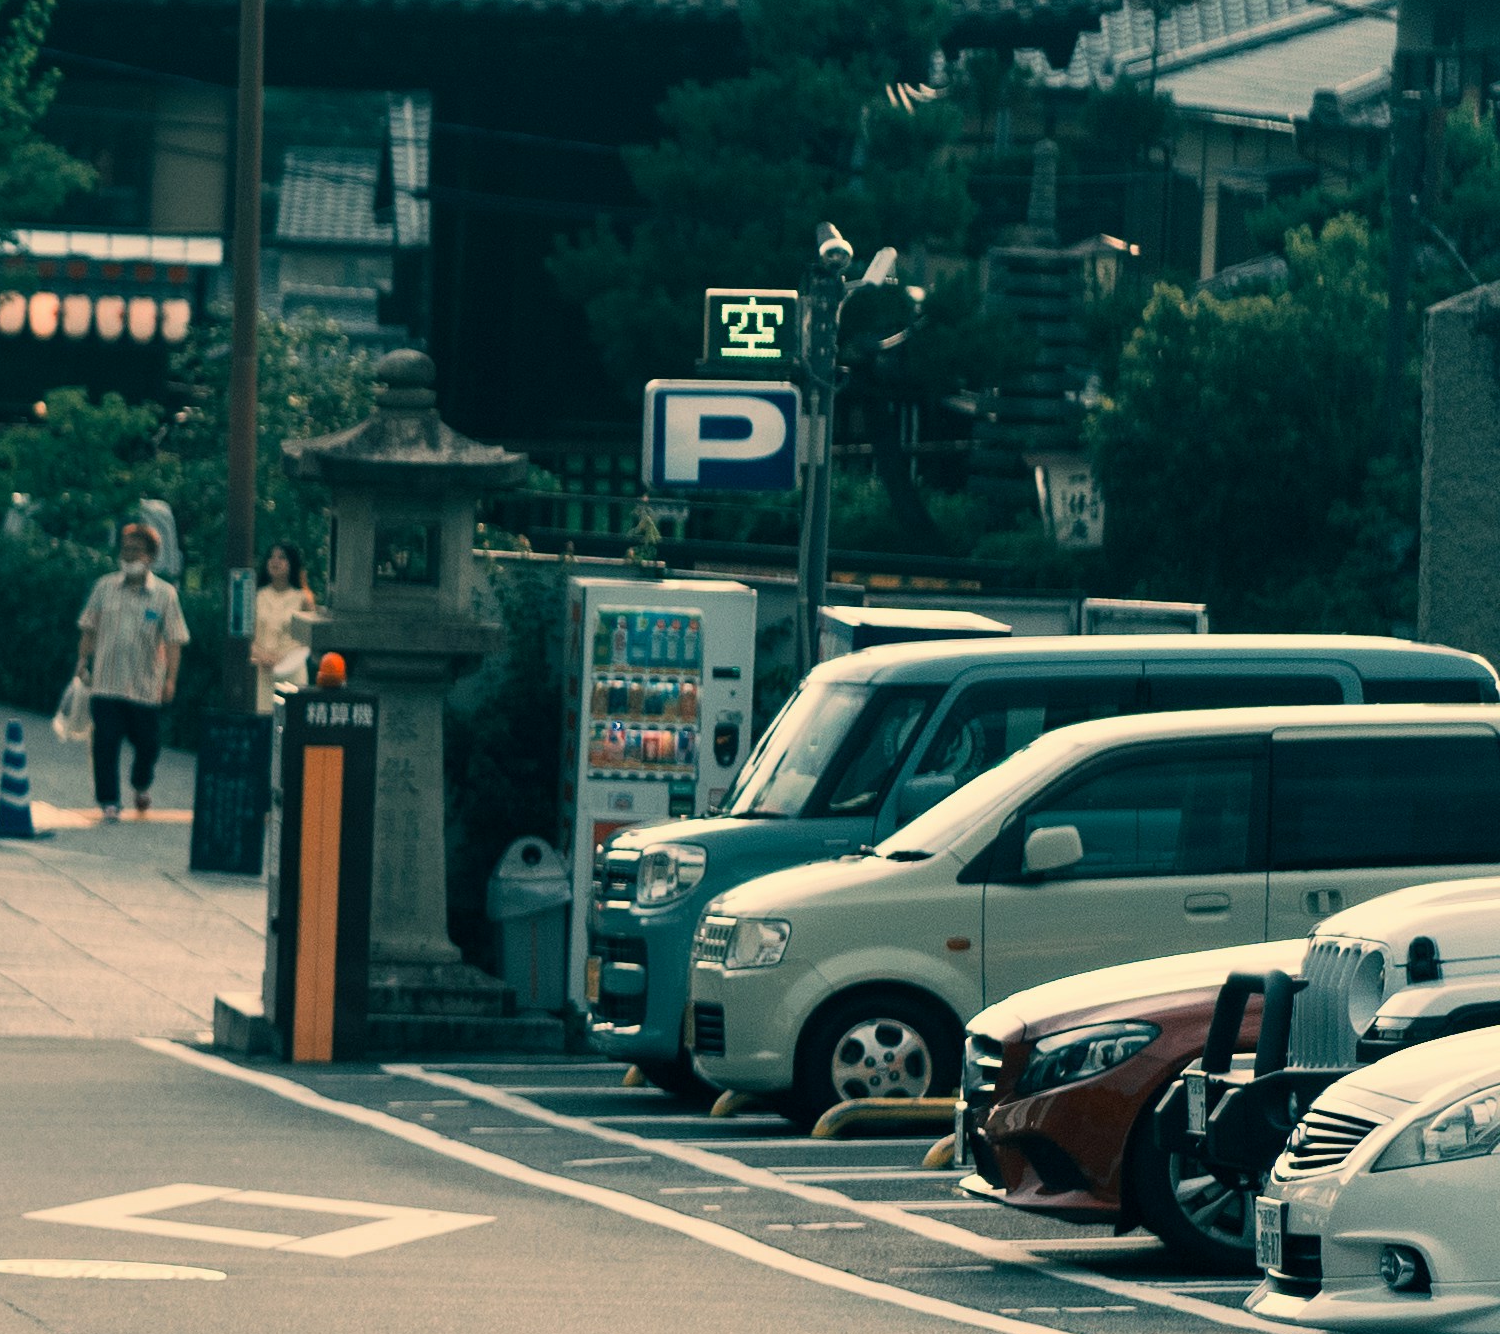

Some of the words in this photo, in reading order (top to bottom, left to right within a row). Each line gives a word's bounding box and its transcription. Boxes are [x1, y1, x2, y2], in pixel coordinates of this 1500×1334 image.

[720, 297, 784, 358] 空
[664, 396, 787, 482] P
[307, 702, 374, 726] 精算機
